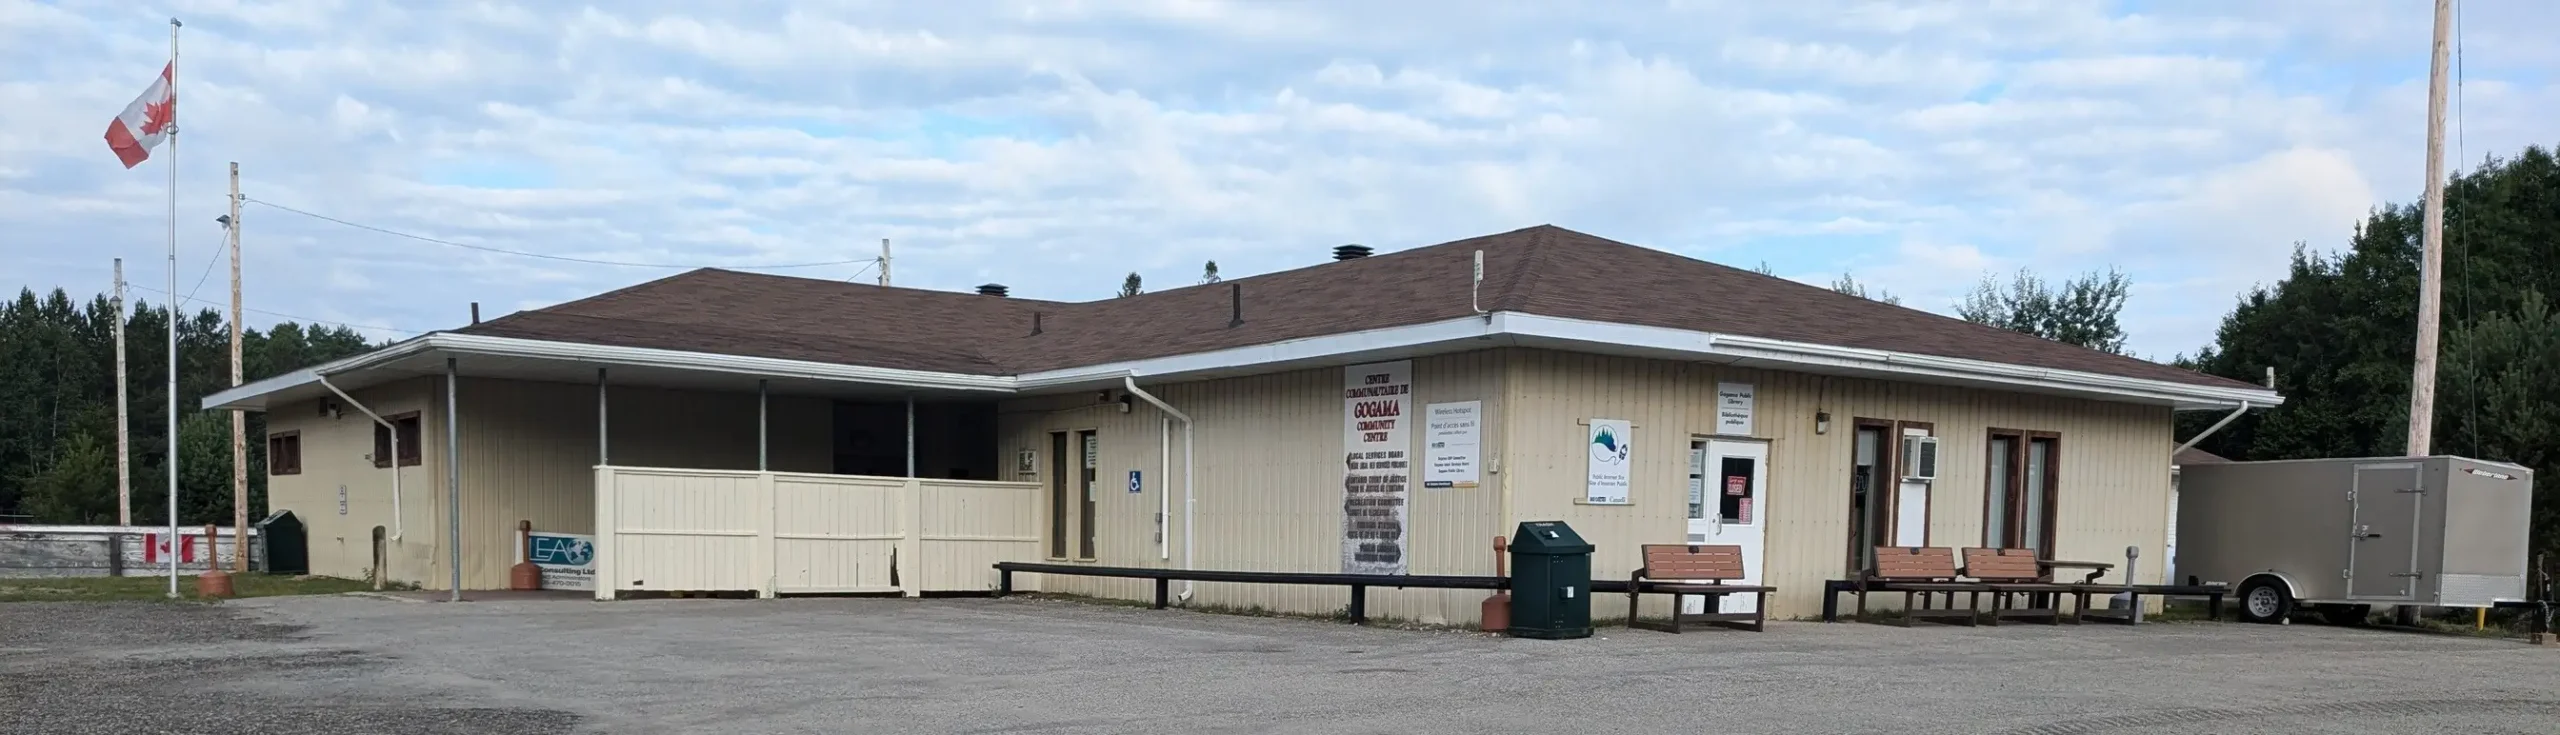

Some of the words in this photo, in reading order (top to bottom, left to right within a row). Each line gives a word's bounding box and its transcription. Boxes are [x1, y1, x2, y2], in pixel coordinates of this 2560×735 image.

[1365, 374, 1390, 385] CENTRE
[1346, 385, 1399, 398] COMMUNAUTAIRE
[1400, 384, 1409, 394] DE
[1354, 400, 1400, 418] GOGAMA
[1357, 420, 1396, 431] COMMUNITY
[1364, 432, 1388, 442] CENTRE
[1365, 452, 1386, 460] SERVICES
[1388, 450, 1404, 458] BOARD
